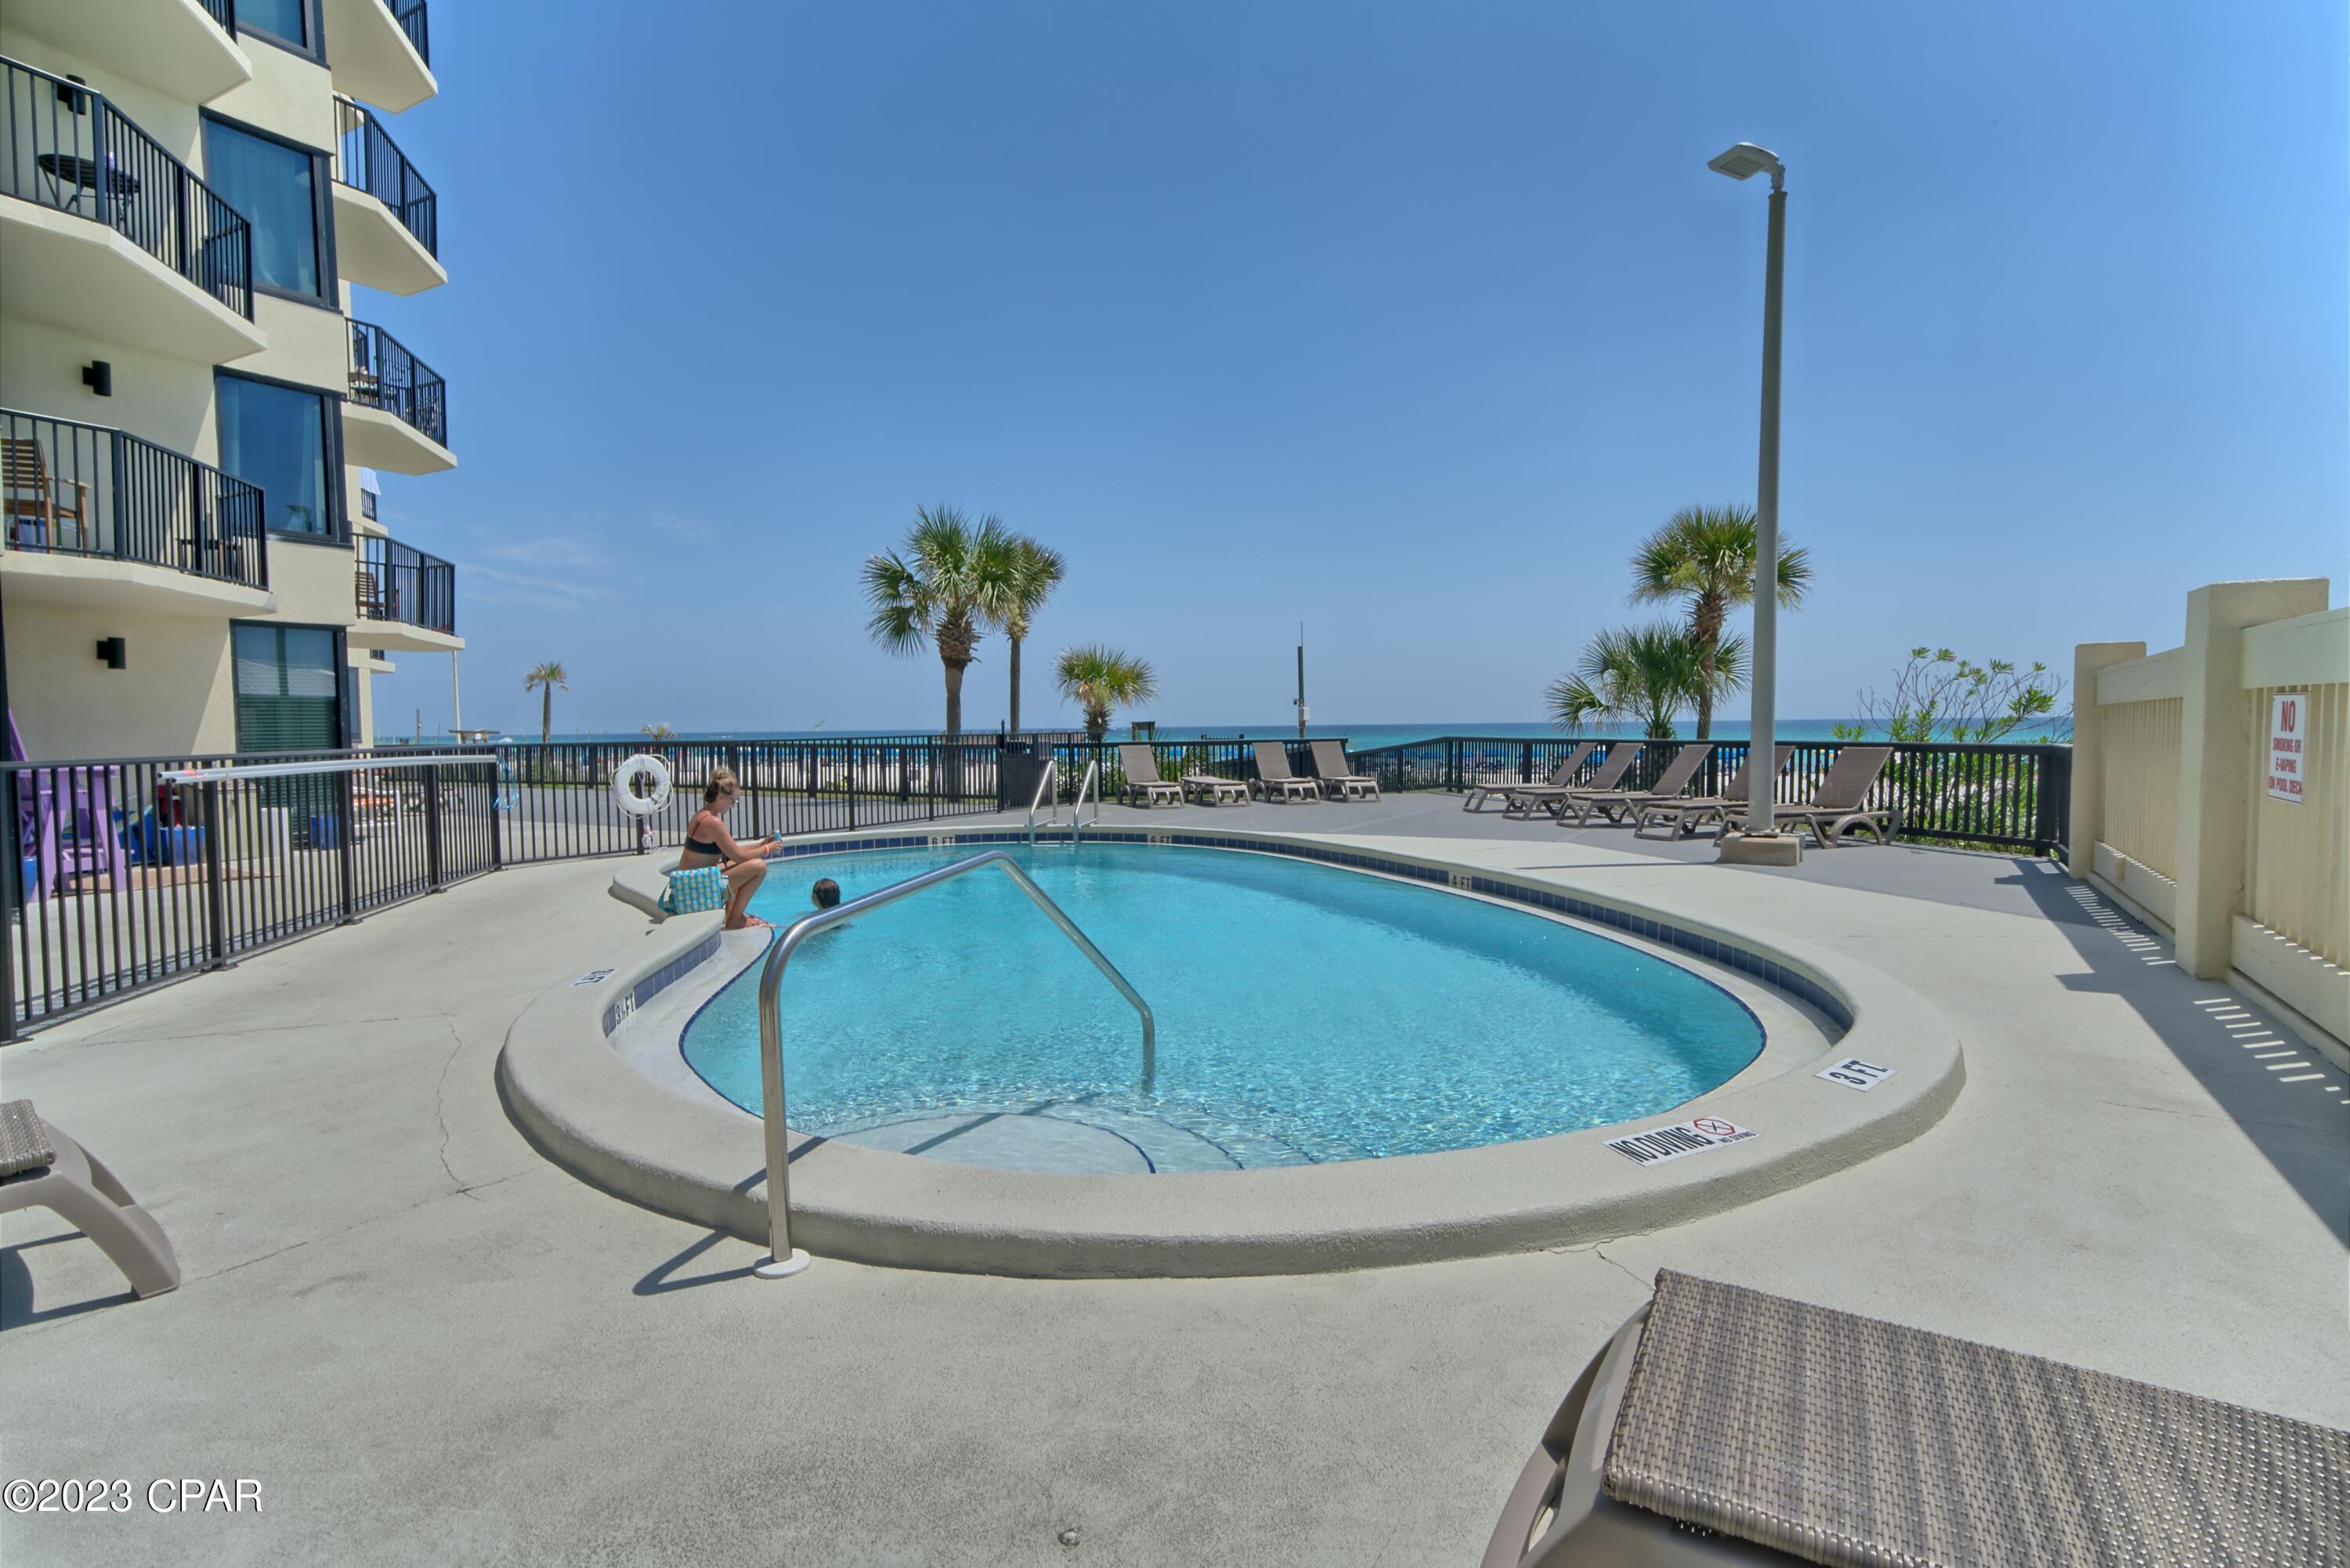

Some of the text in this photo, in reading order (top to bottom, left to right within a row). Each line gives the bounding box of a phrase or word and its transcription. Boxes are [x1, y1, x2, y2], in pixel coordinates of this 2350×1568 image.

[2280, 700, 2296, 732] NO
[2273, 737, 2301, 753] SMOKING OR
[2276, 757, 2297, 774] E-VAPING
[2269, 775, 2303, 796] ON POOL DECK
[942, 836, 953, 845] FT
[1160, 836, 1171, 844] FT
[1452, 874, 1471, 891] 4 FT
[625, 992, 634, 1017] FT
[1828, 1071, 1867, 1085] 3
[1609, 1126, 1716, 1163] NO DIVING
[1728, 1131, 1757, 1141] DIVING
